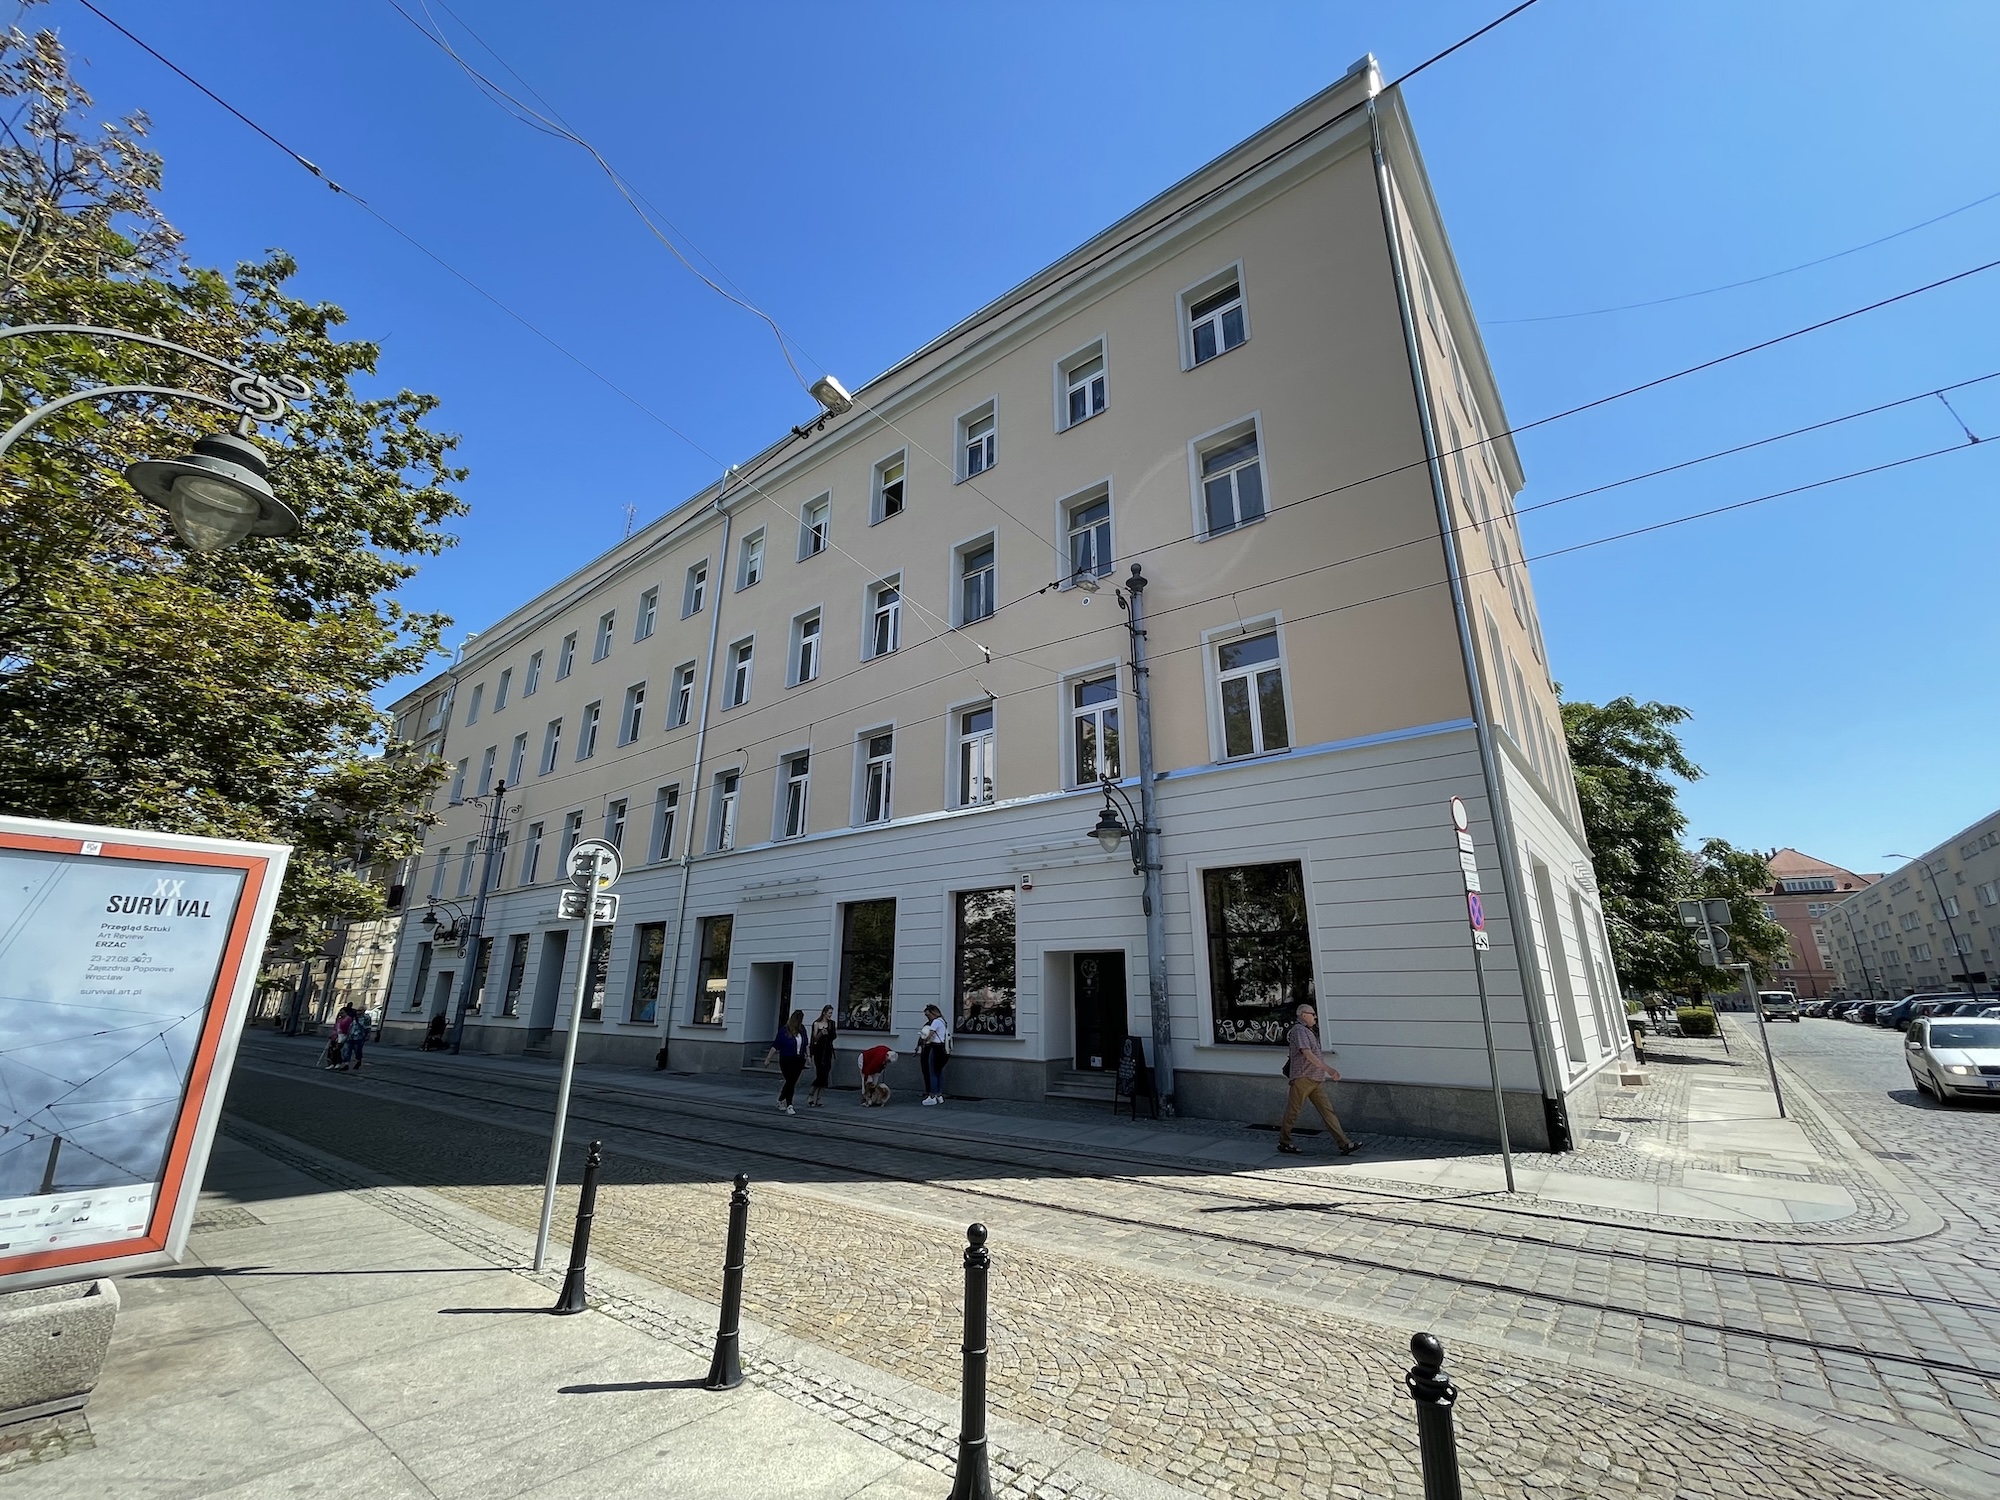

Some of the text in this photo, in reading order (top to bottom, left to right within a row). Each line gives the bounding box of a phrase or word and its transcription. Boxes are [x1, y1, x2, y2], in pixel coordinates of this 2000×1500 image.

[152, 878, 186, 898] XX
[106, 895, 212, 918] SURVIVAL
[101, 922, 171, 932] Przegląd Sztuki
[113, 932, 145, 940] Review
[95, 940, 127, 948] ERZAC
[87, 963, 175, 973] Zajezdnia Popowice
[80, 988, 142, 996] survival.art.pl
